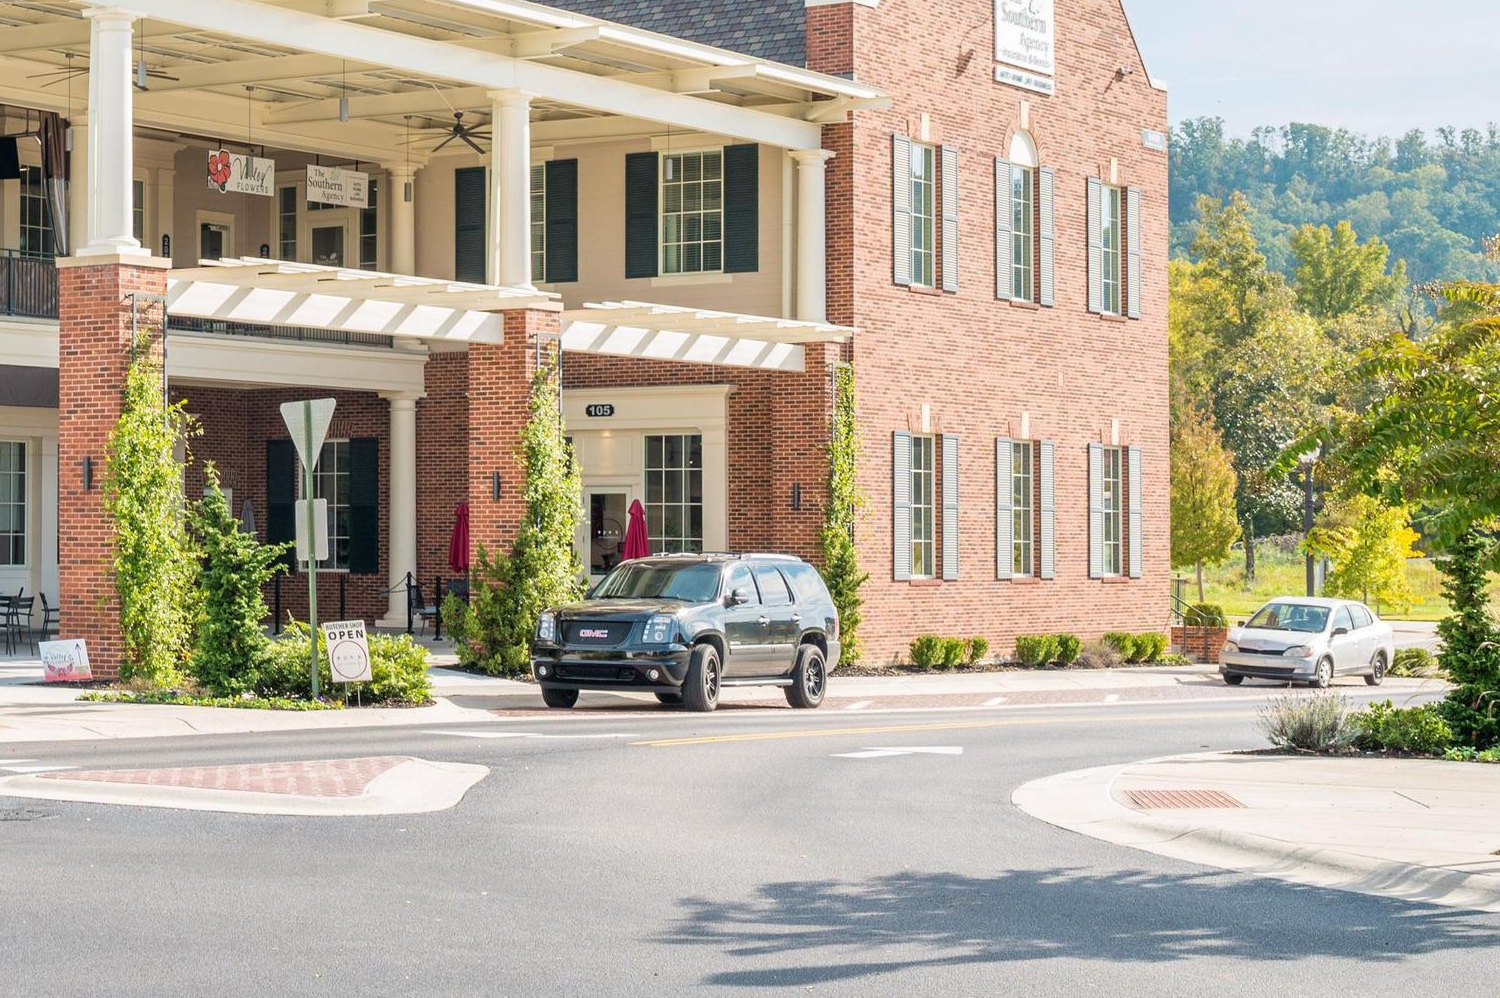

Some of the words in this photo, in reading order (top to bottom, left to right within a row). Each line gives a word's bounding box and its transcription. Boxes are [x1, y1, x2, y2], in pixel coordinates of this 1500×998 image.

[314, 168, 325, 177] The
[236, 181, 269, 194] FLOWERS
[308, 176, 343, 191] Southern
[321, 190, 345, 202] Agency
[589, 405, 611, 416] 105
[328, 629, 364, 640] OPEN
[580, 629, 608, 637] GMC
